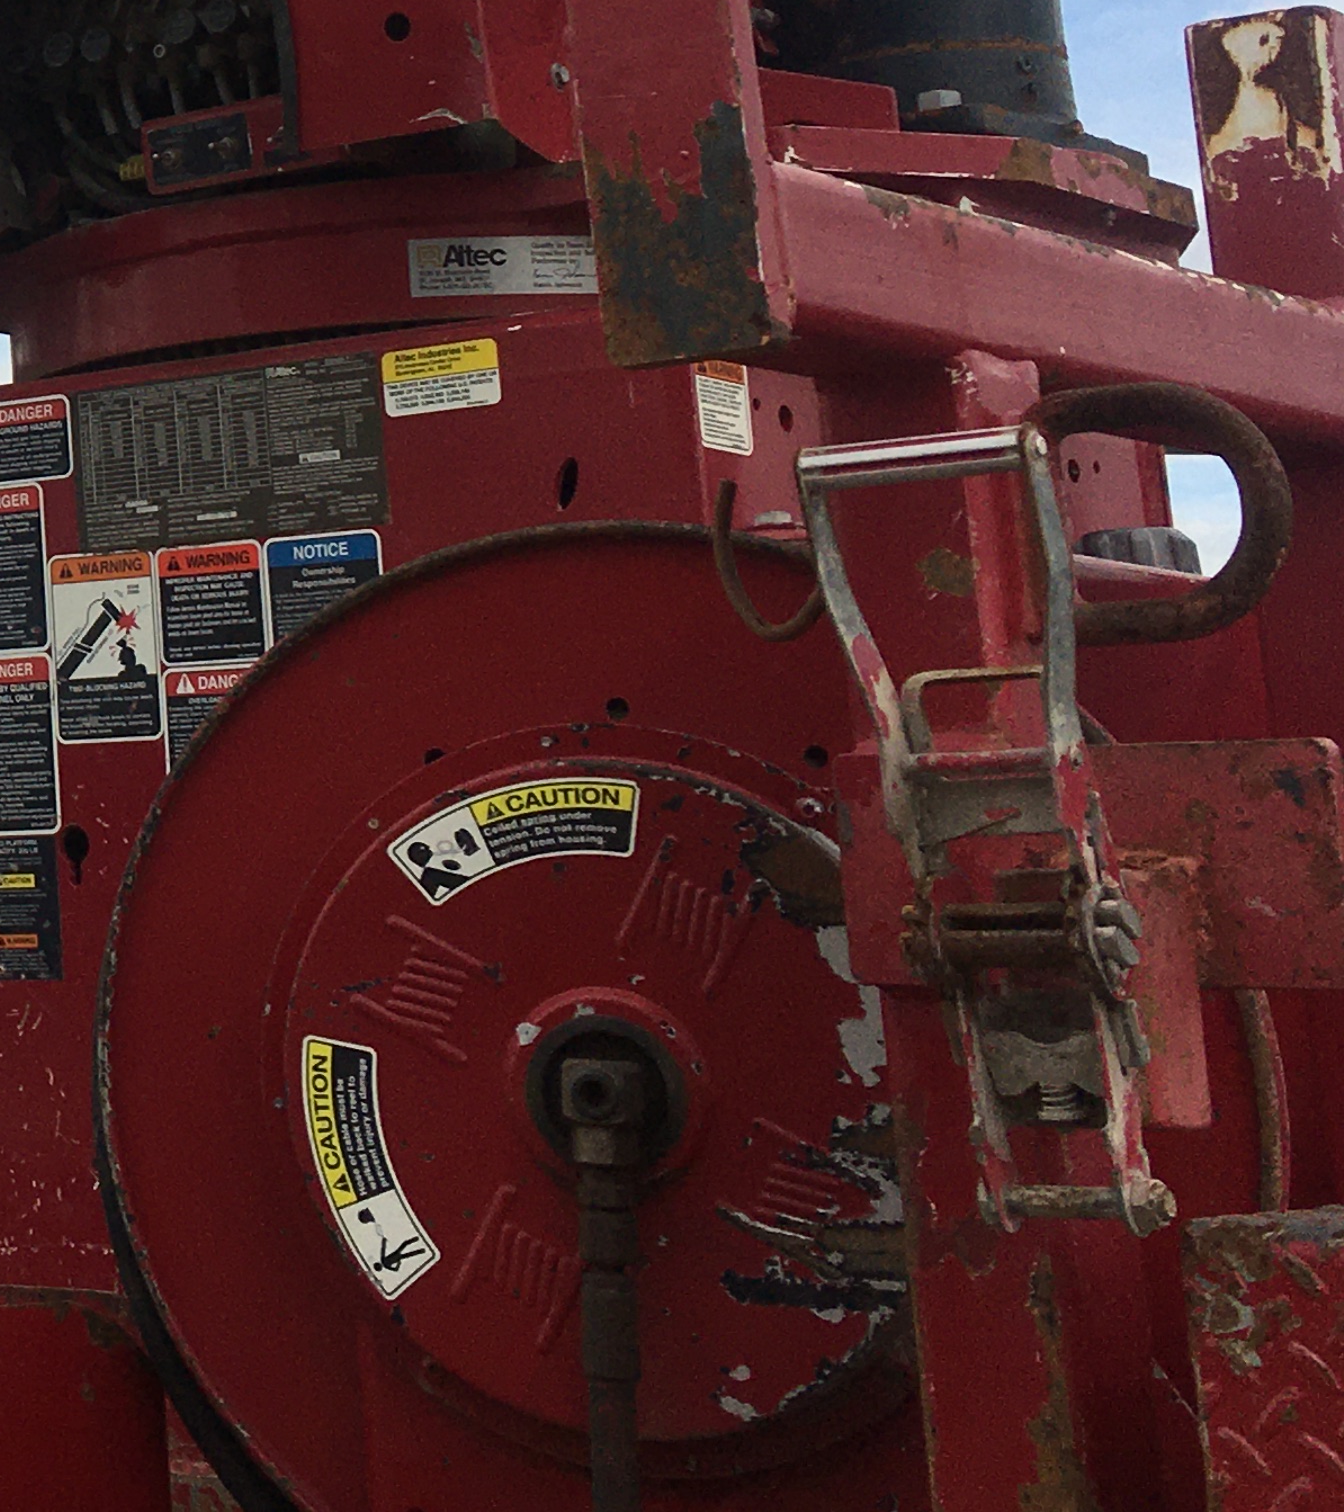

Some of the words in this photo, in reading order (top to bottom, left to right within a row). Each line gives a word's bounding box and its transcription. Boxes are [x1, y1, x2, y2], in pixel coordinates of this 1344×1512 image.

[443, 245, 506, 267] Altec
[394, 353, 416, 362] Altec
[418, 347, 461, 360] Industries
[185, 550, 250, 569] WARNING
[293, 541, 349, 560] NOTICE
[78, 558, 143, 575] WARNING
[301, 566, 345, 578] Ownership
[292, 576, 356, 589] Responsibilities
[197, 674, 243, 690] DANG
[15, 693, 35, 703] ONLY
[506, 787, 620, 813] CAUTION
[484, 819, 518, 836] Coiled
[521, 813, 557, 827] spring
[559, 812, 592, 821] under
[535, 826, 550, 835] Do
[553, 824, 572, 833] not
[575, 824, 617, 834] remove
[494, 841, 529, 859] spring
[530, 836, 556, 848] from
[336, 1078, 344, 1092] be
[348, 1075, 356, 1087] to
[358, 1058, 368, 1100] damage
[337, 1093, 347, 1120] must
[348, 1088, 358, 1110] reel
[361, 1101, 369, 1113] or
[312, 1054, 341, 1170] CAUTION
[350, 1112, 358, 1124] to
[342, 1123, 353, 1151] cable
[352, 1125, 365, 1152] back
[363, 1116, 376, 1146] injury
[348, 1155, 356, 1166] or
[369, 1149, 390, 1189] prevent
[358, 1153, 377, 1190] walked
[353, 1169, 367, 1196] Hose
